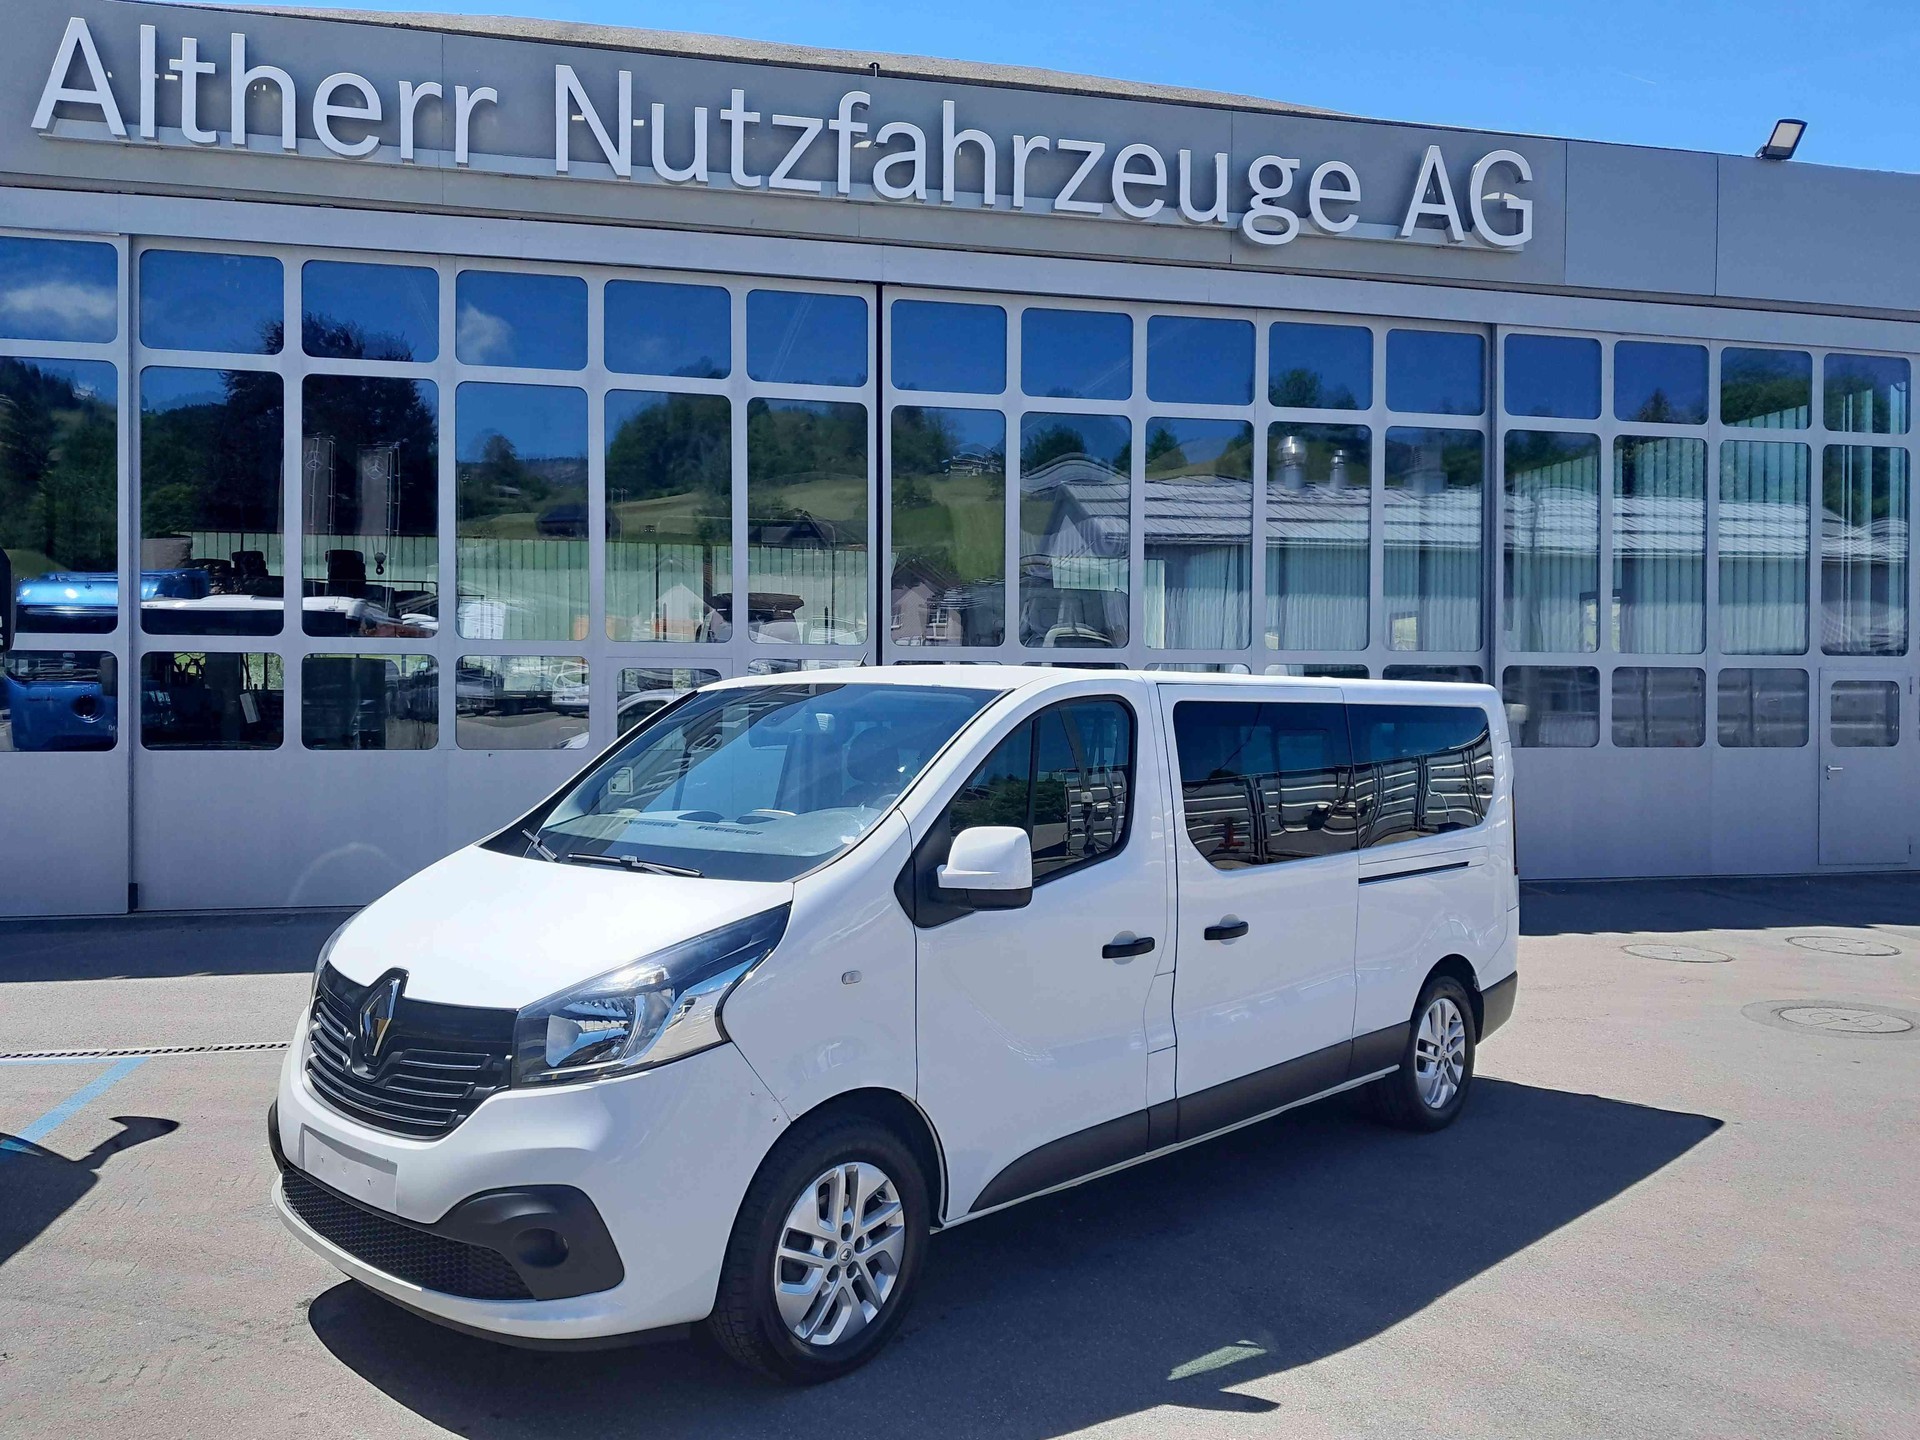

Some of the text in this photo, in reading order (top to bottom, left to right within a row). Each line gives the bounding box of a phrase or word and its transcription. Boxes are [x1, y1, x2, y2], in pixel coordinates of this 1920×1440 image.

[31, 17, 1534, 249] Altherr Nutzfahrzeuge AG
